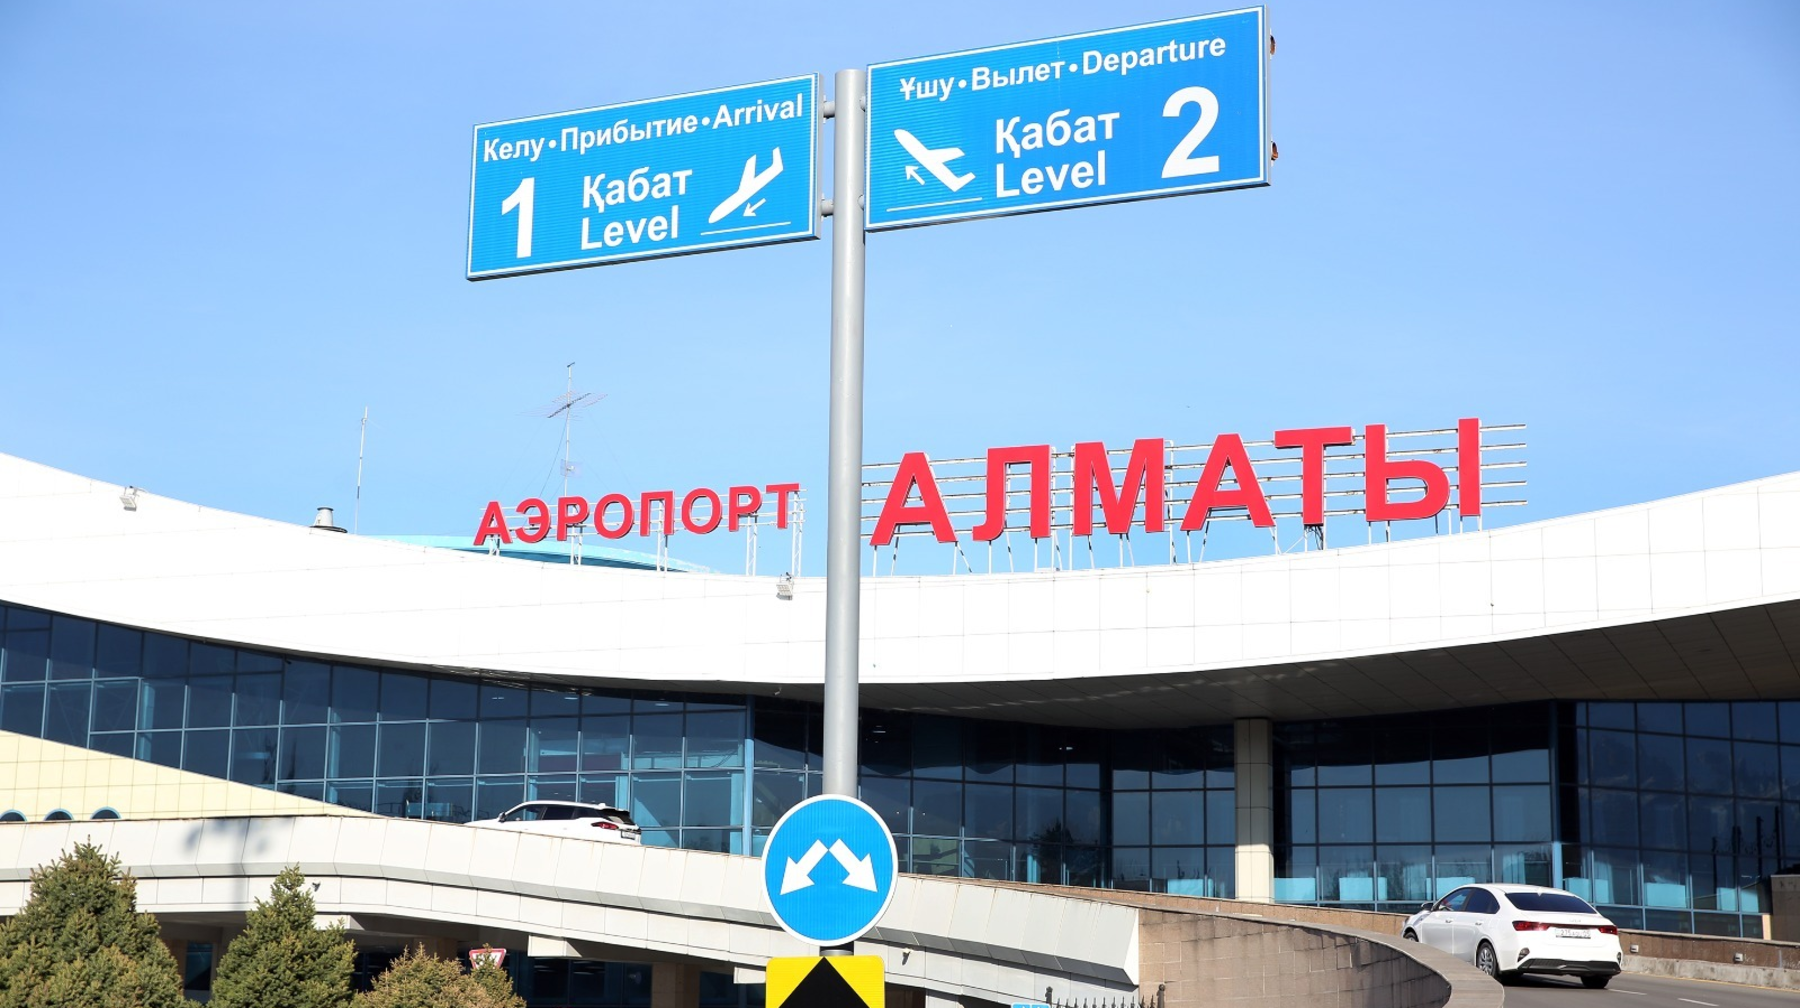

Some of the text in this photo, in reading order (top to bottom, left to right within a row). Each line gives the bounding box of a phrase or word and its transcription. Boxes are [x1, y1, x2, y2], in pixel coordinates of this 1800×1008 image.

[899, 37, 1227, 102] Ұшу Вылет Departure
[483, 93, 803, 163] Келу Прибытие Arrival
[995, 109, 1121, 159] Қабат
[1161, 86, 1220, 179] 2
[582, 166, 693, 214] Қабат
[996, 150, 1106, 198] Level
[501, 177, 535, 259] 1
[580, 205, 679, 251] Level
[474, 418, 1481, 546] АЭРОПОРТ АЛМАТЫ
